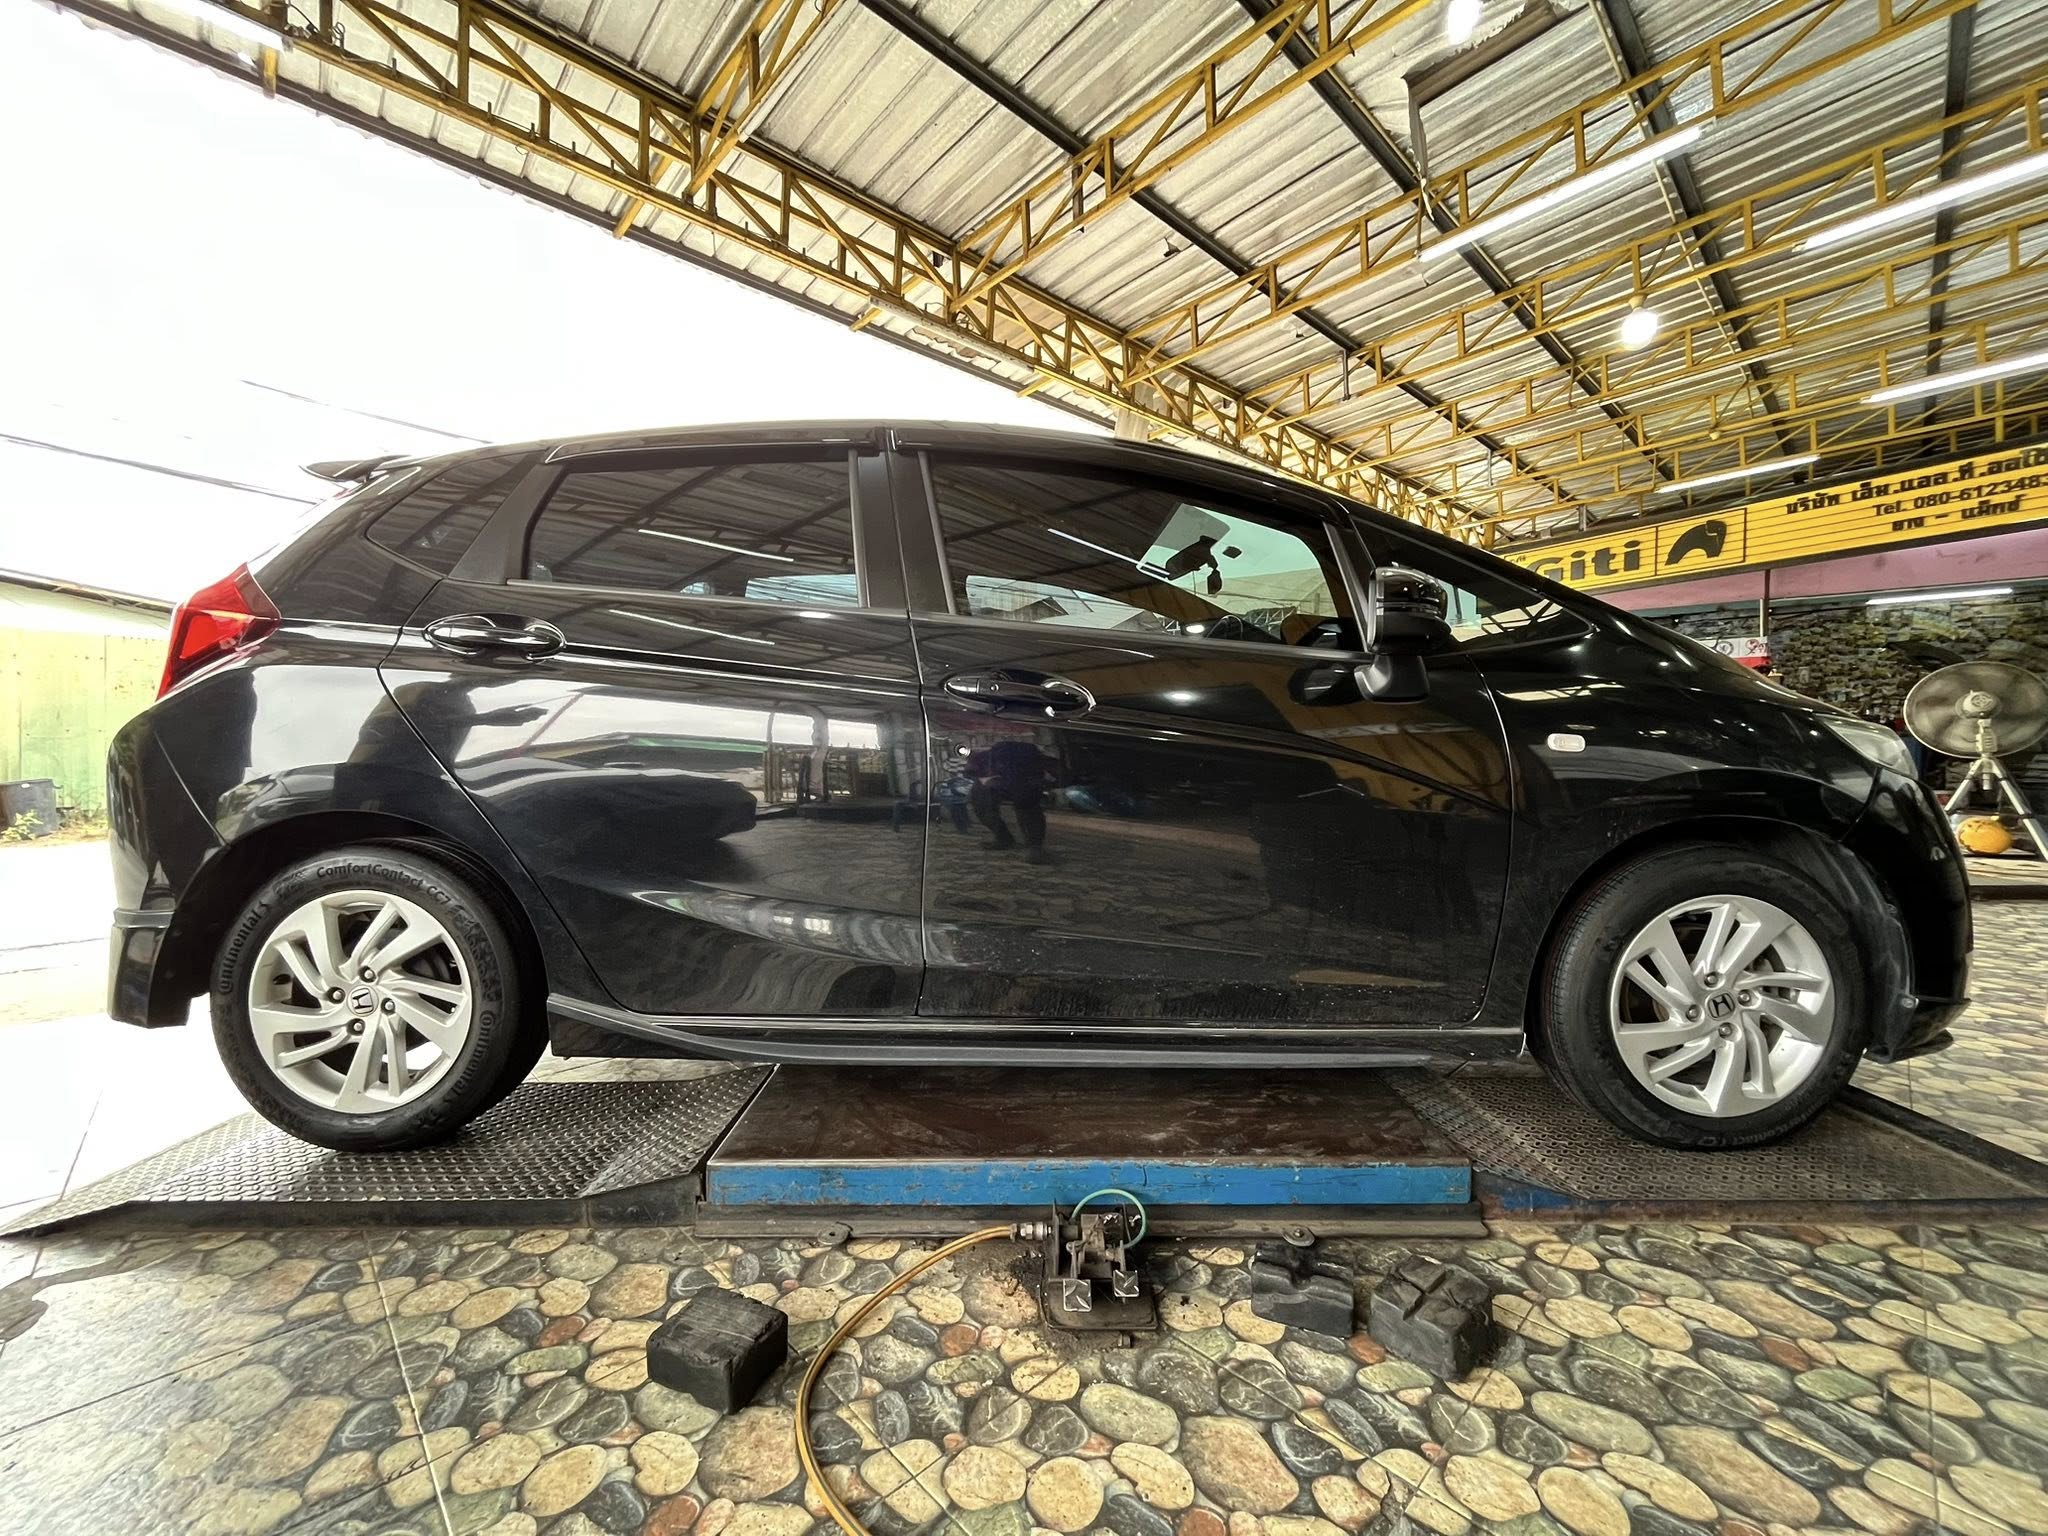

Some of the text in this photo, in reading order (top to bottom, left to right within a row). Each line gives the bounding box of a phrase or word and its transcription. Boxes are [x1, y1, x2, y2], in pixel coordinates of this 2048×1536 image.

[1786, 492, 1841, 515] บริษัท
[1872, 501, 1909, 517] Tel.
[1525, 540, 1641, 583] Giti
[316, 862, 424, 888] ComfortContact
